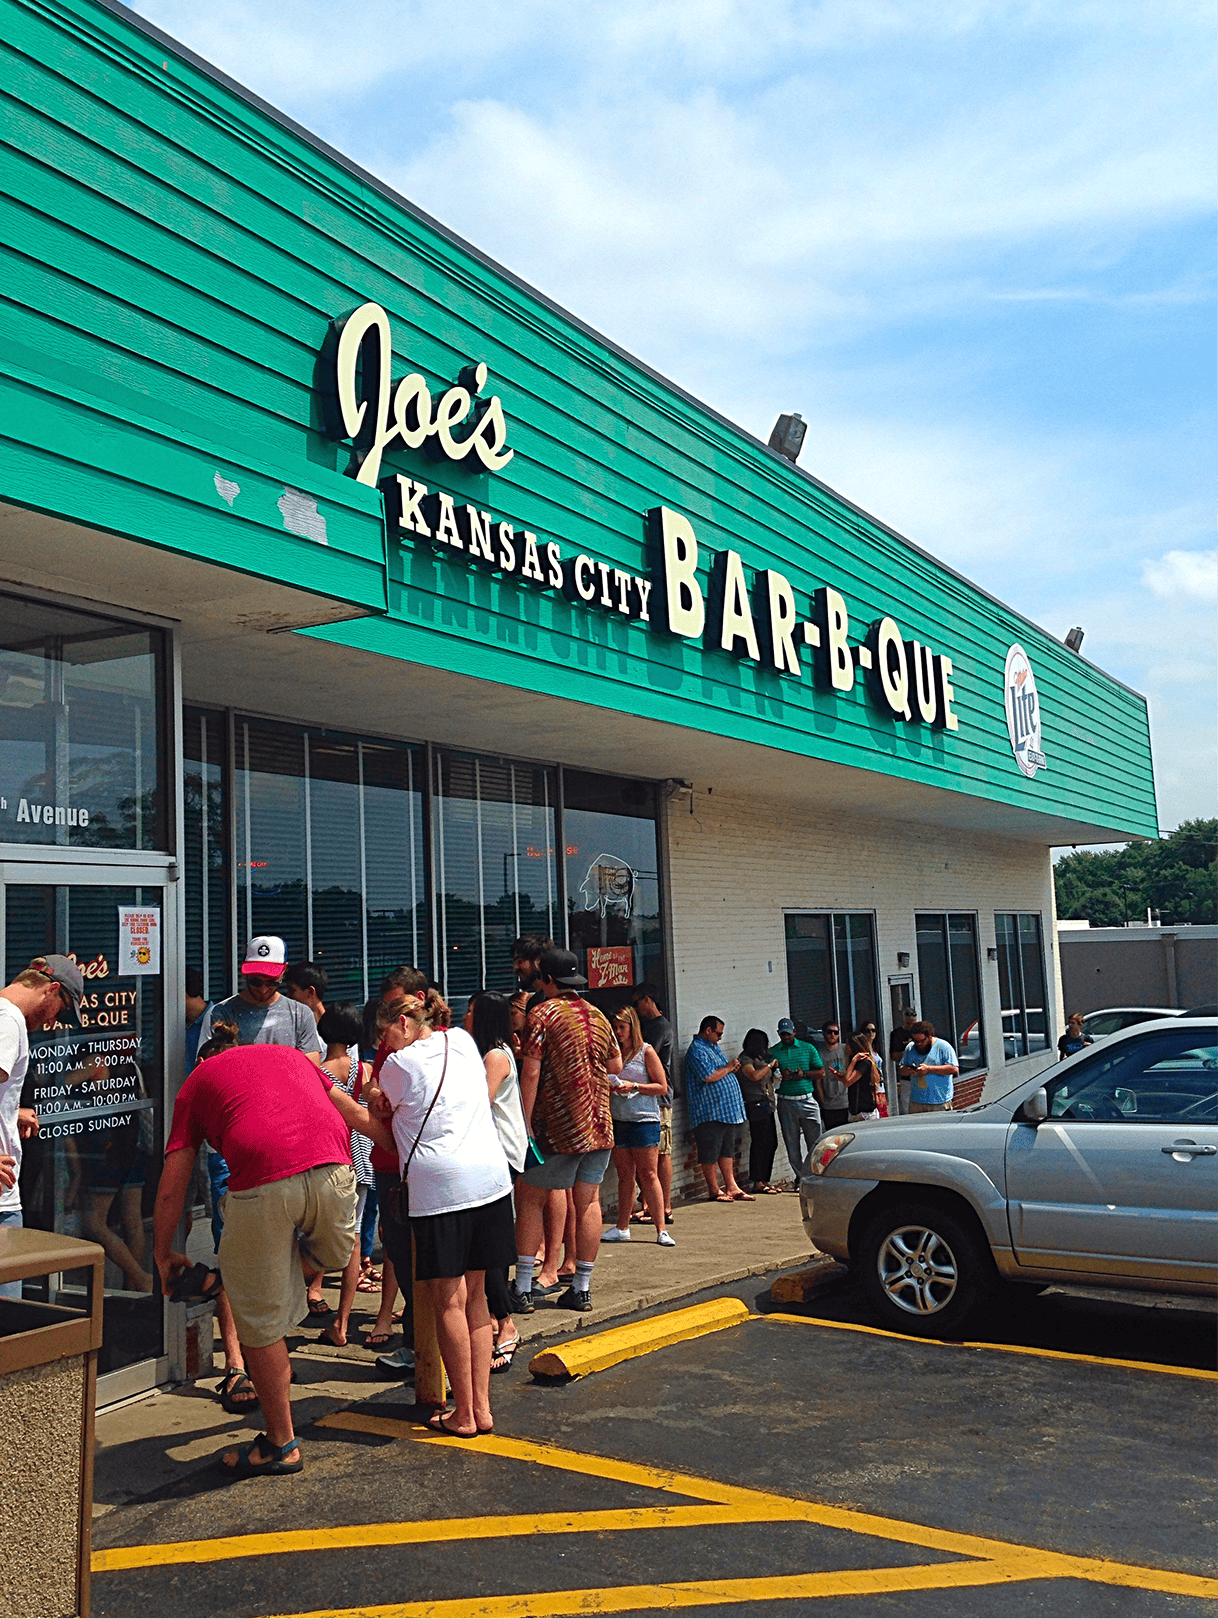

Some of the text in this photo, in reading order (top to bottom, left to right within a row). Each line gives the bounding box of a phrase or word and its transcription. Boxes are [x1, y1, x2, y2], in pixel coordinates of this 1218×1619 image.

[338, 302, 514, 488] Joe's
[396, 473, 651, 621] KANSAS CITY
[662, 505, 959, 732] BAR-B-QUE
[16, 798, 89, 827] Avenue
[104, 991, 137, 1007] CITY
[29, 1043, 80, 1060] MONDAY
[88, 1037, 142, 1053] THURSDAY
[36, 1061, 63, 1075] 11:00
[65, 1061, 86, 1071] A.M.
[94, 1055, 118, 1068] 9:00
[119, 1055, 136, 1065] P.M.
[34, 1084, 73, 1100] FRIDAY
[81, 1075, 136, 1093] SATURDAY
[34, 1101, 61, 1115] 11:00
[63, 1101, 84, 1111] A.M.
[92, 1093, 120, 1107] 10:00
[121, 1093, 138, 1102] P.M.
[38, 1114, 132, 1140] CLOSED SUNDAY
